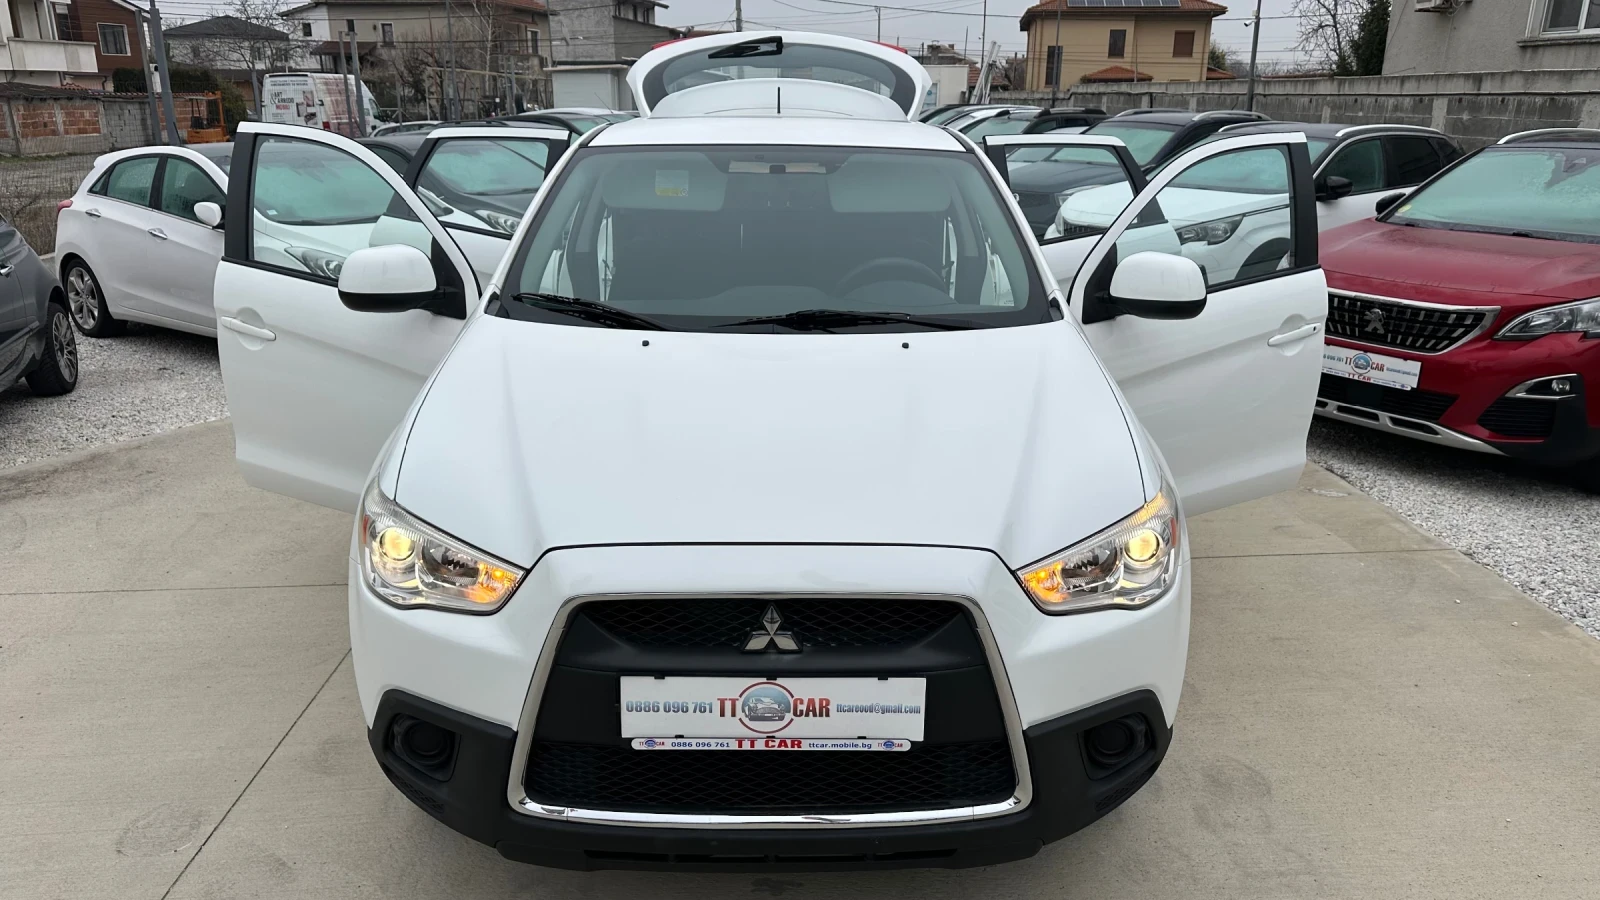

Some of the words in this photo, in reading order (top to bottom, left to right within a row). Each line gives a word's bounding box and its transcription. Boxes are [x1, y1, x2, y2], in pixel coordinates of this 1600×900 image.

[1345, 356, 1352, 365] TT
[1370, 362, 1385, 372] CAR
[625, 701, 660, 713] 0886
[663, 702, 689, 713] 096
[692, 702, 713, 713] 761
[717, 698, 739, 717] TT
[792, 698, 831, 718] CAR
[836, 703, 921, 714] ttcareood@gmail.com
[735, 739, 758, 748] TT
[764, 739, 803, 749] CAR
